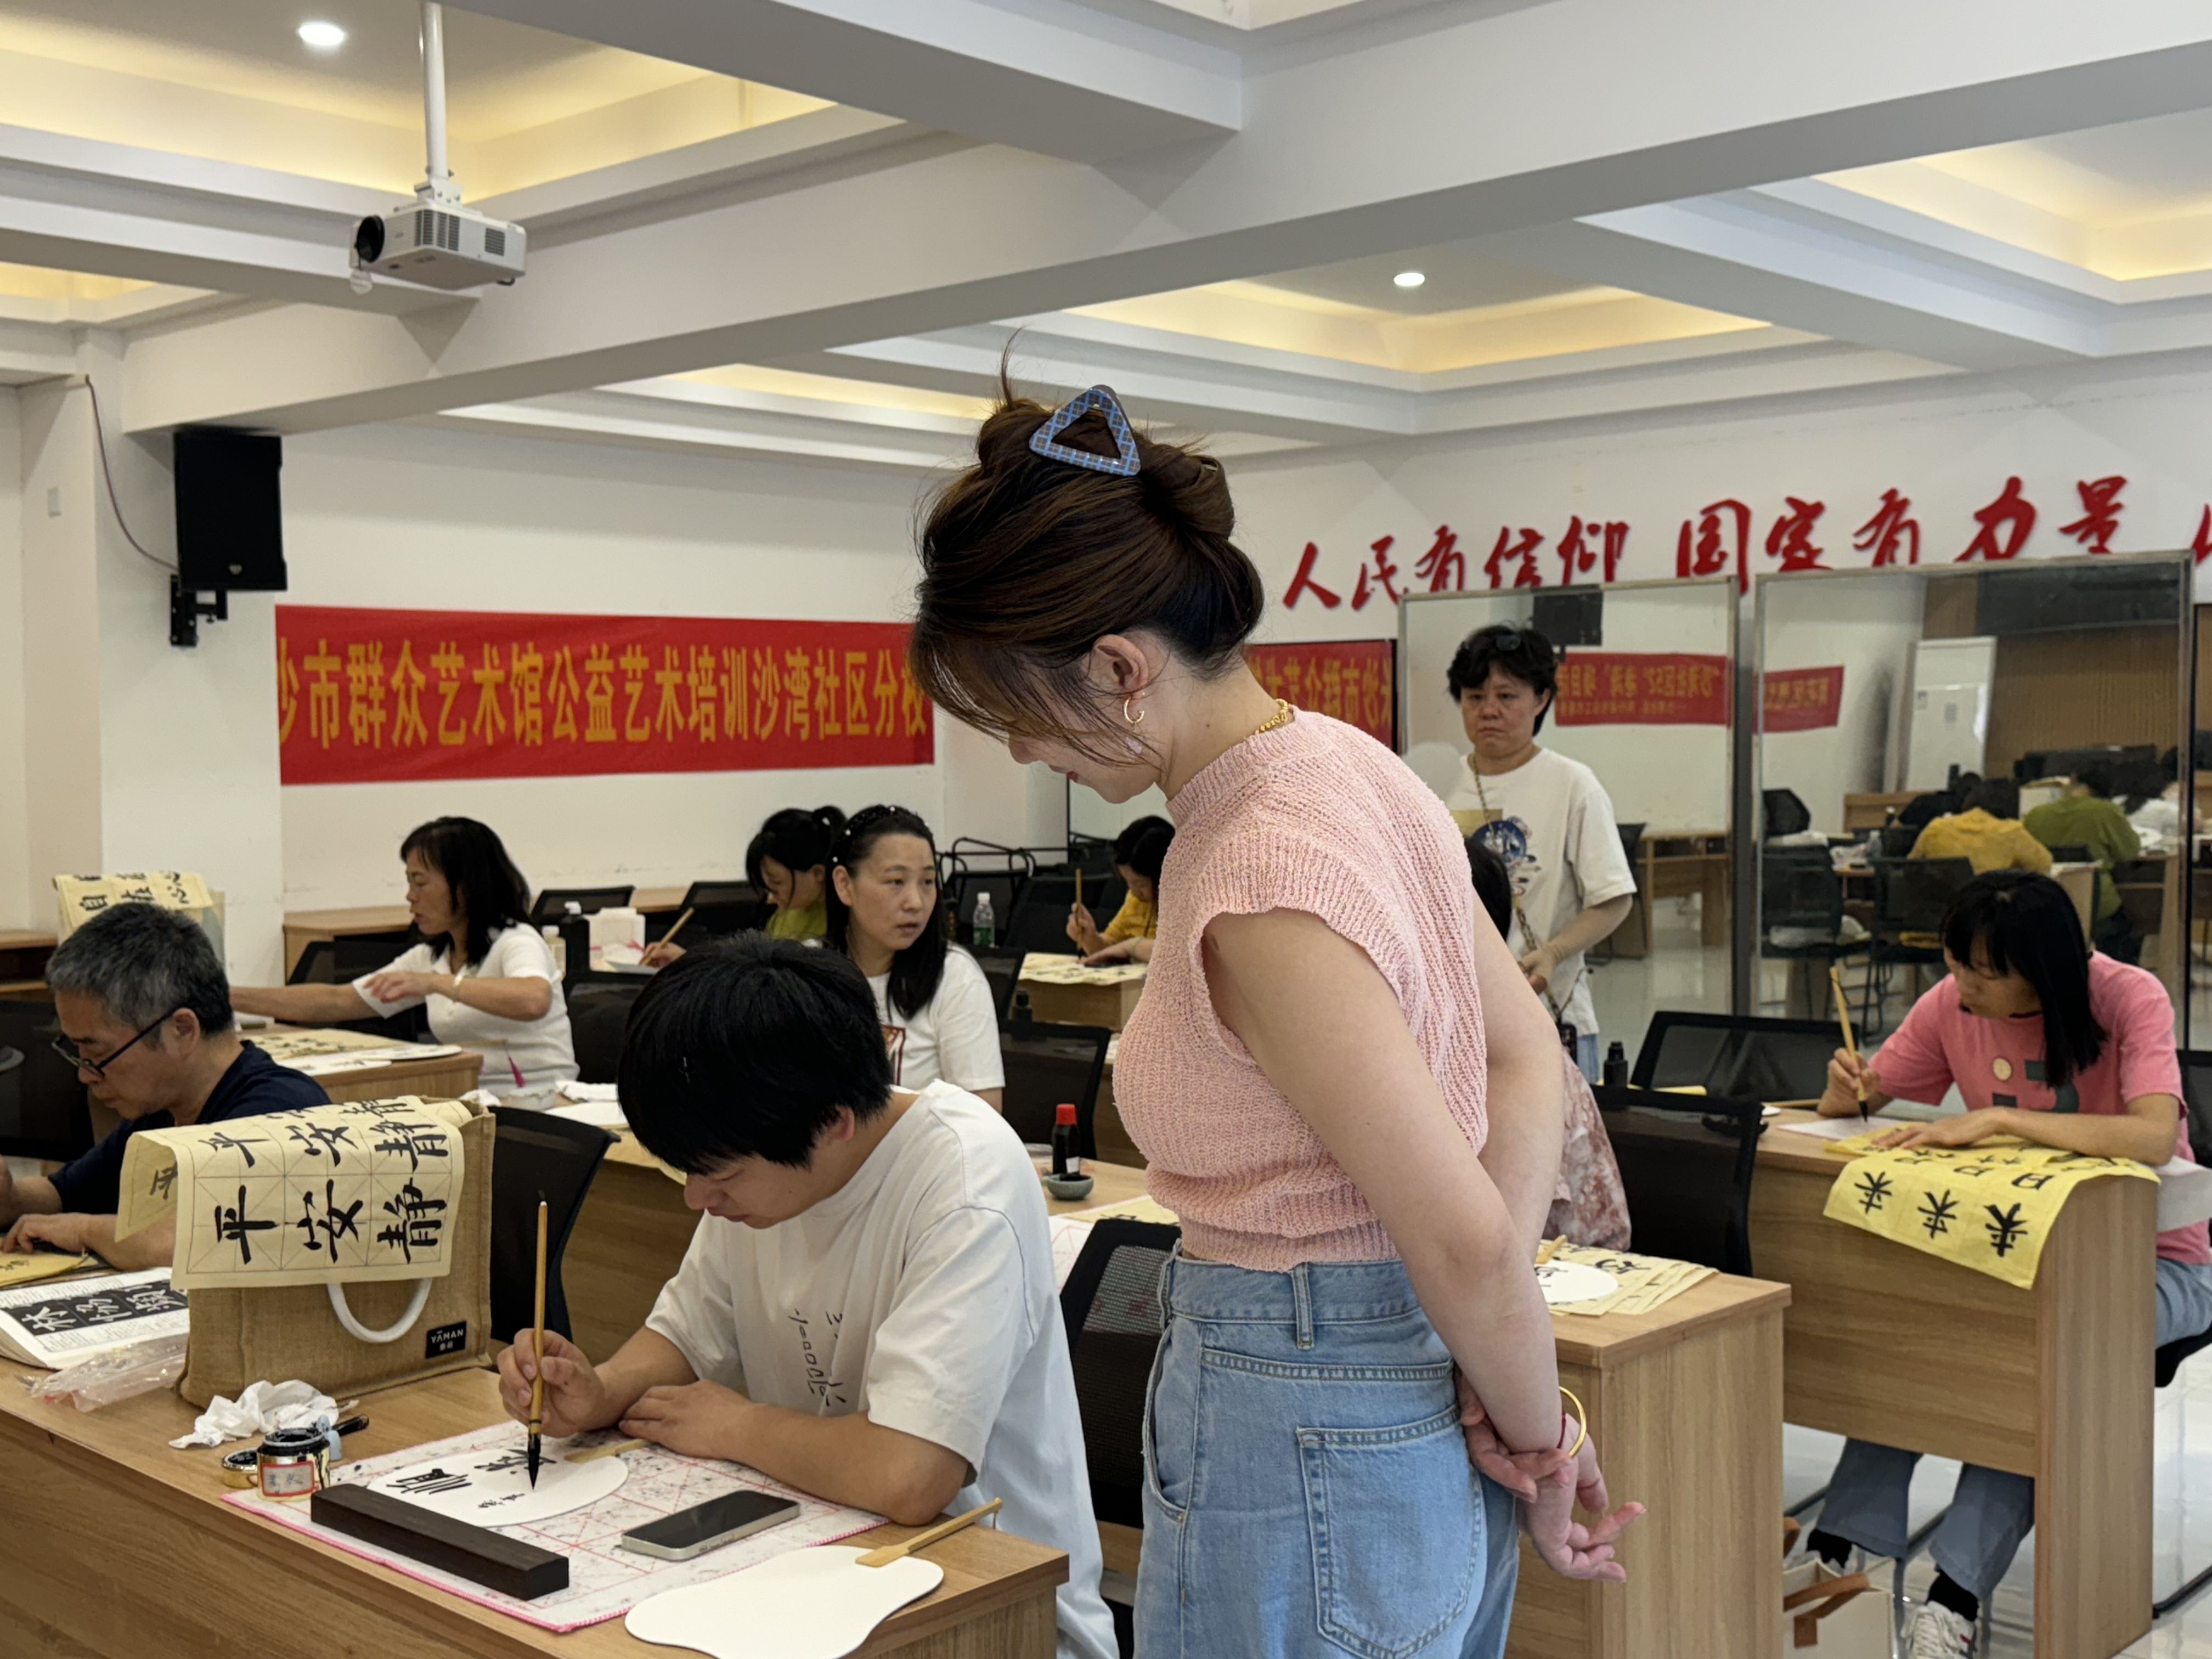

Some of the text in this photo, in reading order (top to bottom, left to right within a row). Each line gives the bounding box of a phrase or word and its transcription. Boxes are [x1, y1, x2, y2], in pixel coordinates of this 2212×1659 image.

[1283, 515, 1630, 611] 人民有信仰
[1676, 476, 2128, 595] 国家有力量
[216, 1177, 447, 1265] 平安静
